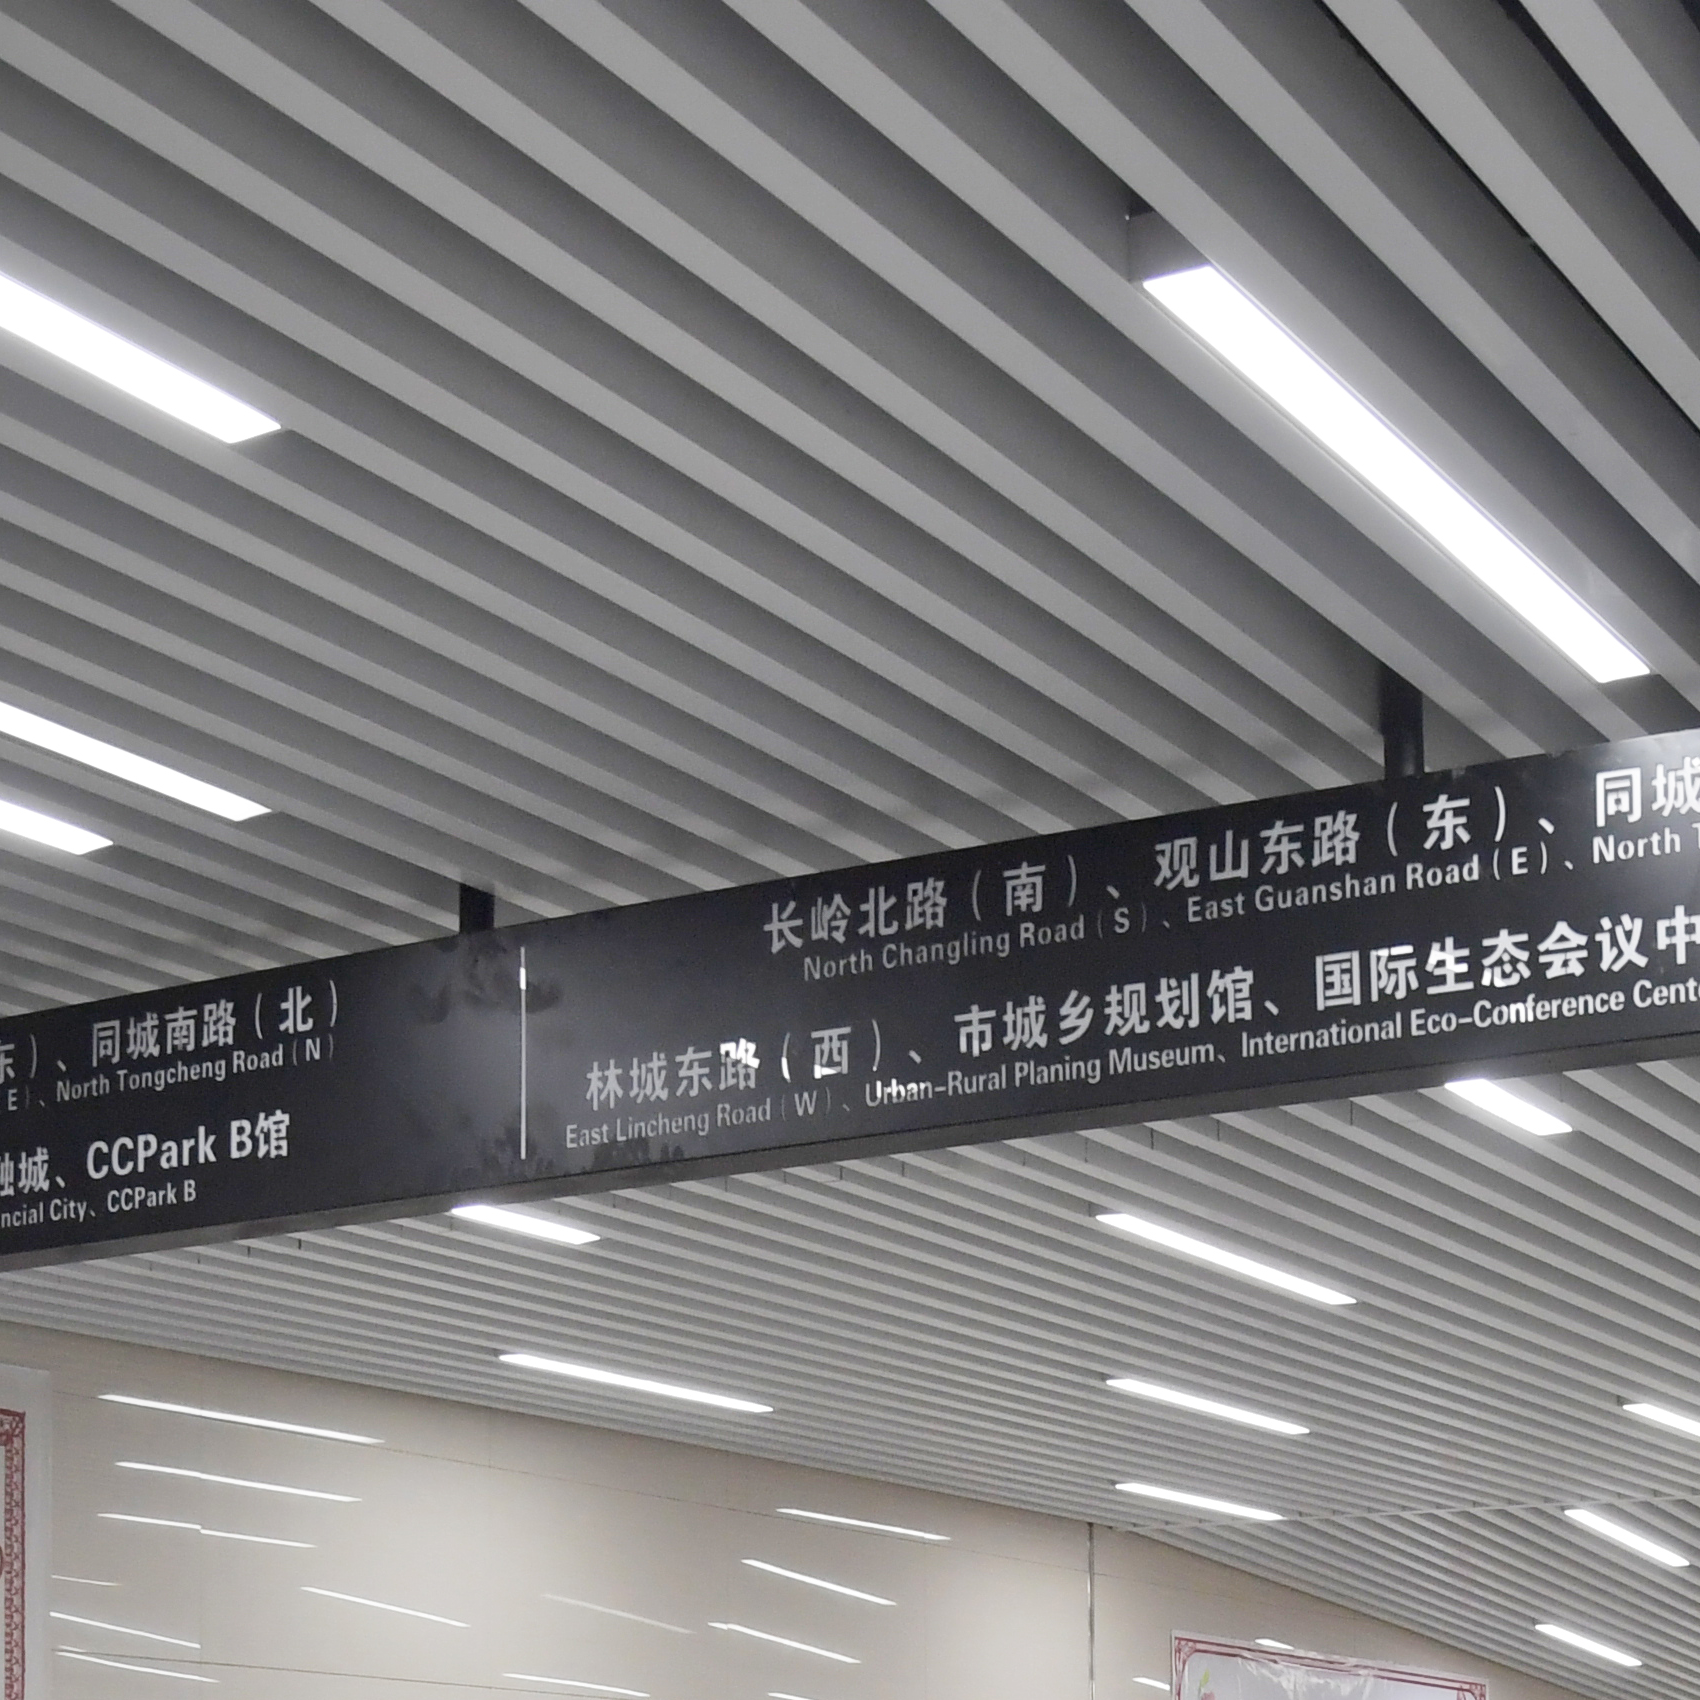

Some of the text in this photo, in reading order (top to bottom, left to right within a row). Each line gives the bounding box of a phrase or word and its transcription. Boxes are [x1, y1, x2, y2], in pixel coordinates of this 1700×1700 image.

[804, 949, 873, 981] North
[882, 930, 1010, 969] Changling
[1020, 914, 1085, 948] Road
[1188, 890, 1245, 923] East
[1255, 872, 1396, 912] Guanshan
[1406, 854, 1480, 889] Road
[1592, 827, 1681, 864] North
[56, 1072, 110, 1102] North
[117, 1060, 227, 1092] Tongcheng
[232, 1043, 284, 1073] Road
[565, 1121, 609, 1150] East
[617, 1110, 709, 1141] Lincheng
[717, 1097, 771, 1128] Road
[1014, 1054, 1102, 1088] Planing
[1242, 1012, 1402, 1058] International
[1411, 989, 1625, 1037] Eco-Conference
[107, 1183, 178, 1214] CCPark
[184, 1179, 198, 1203] B
